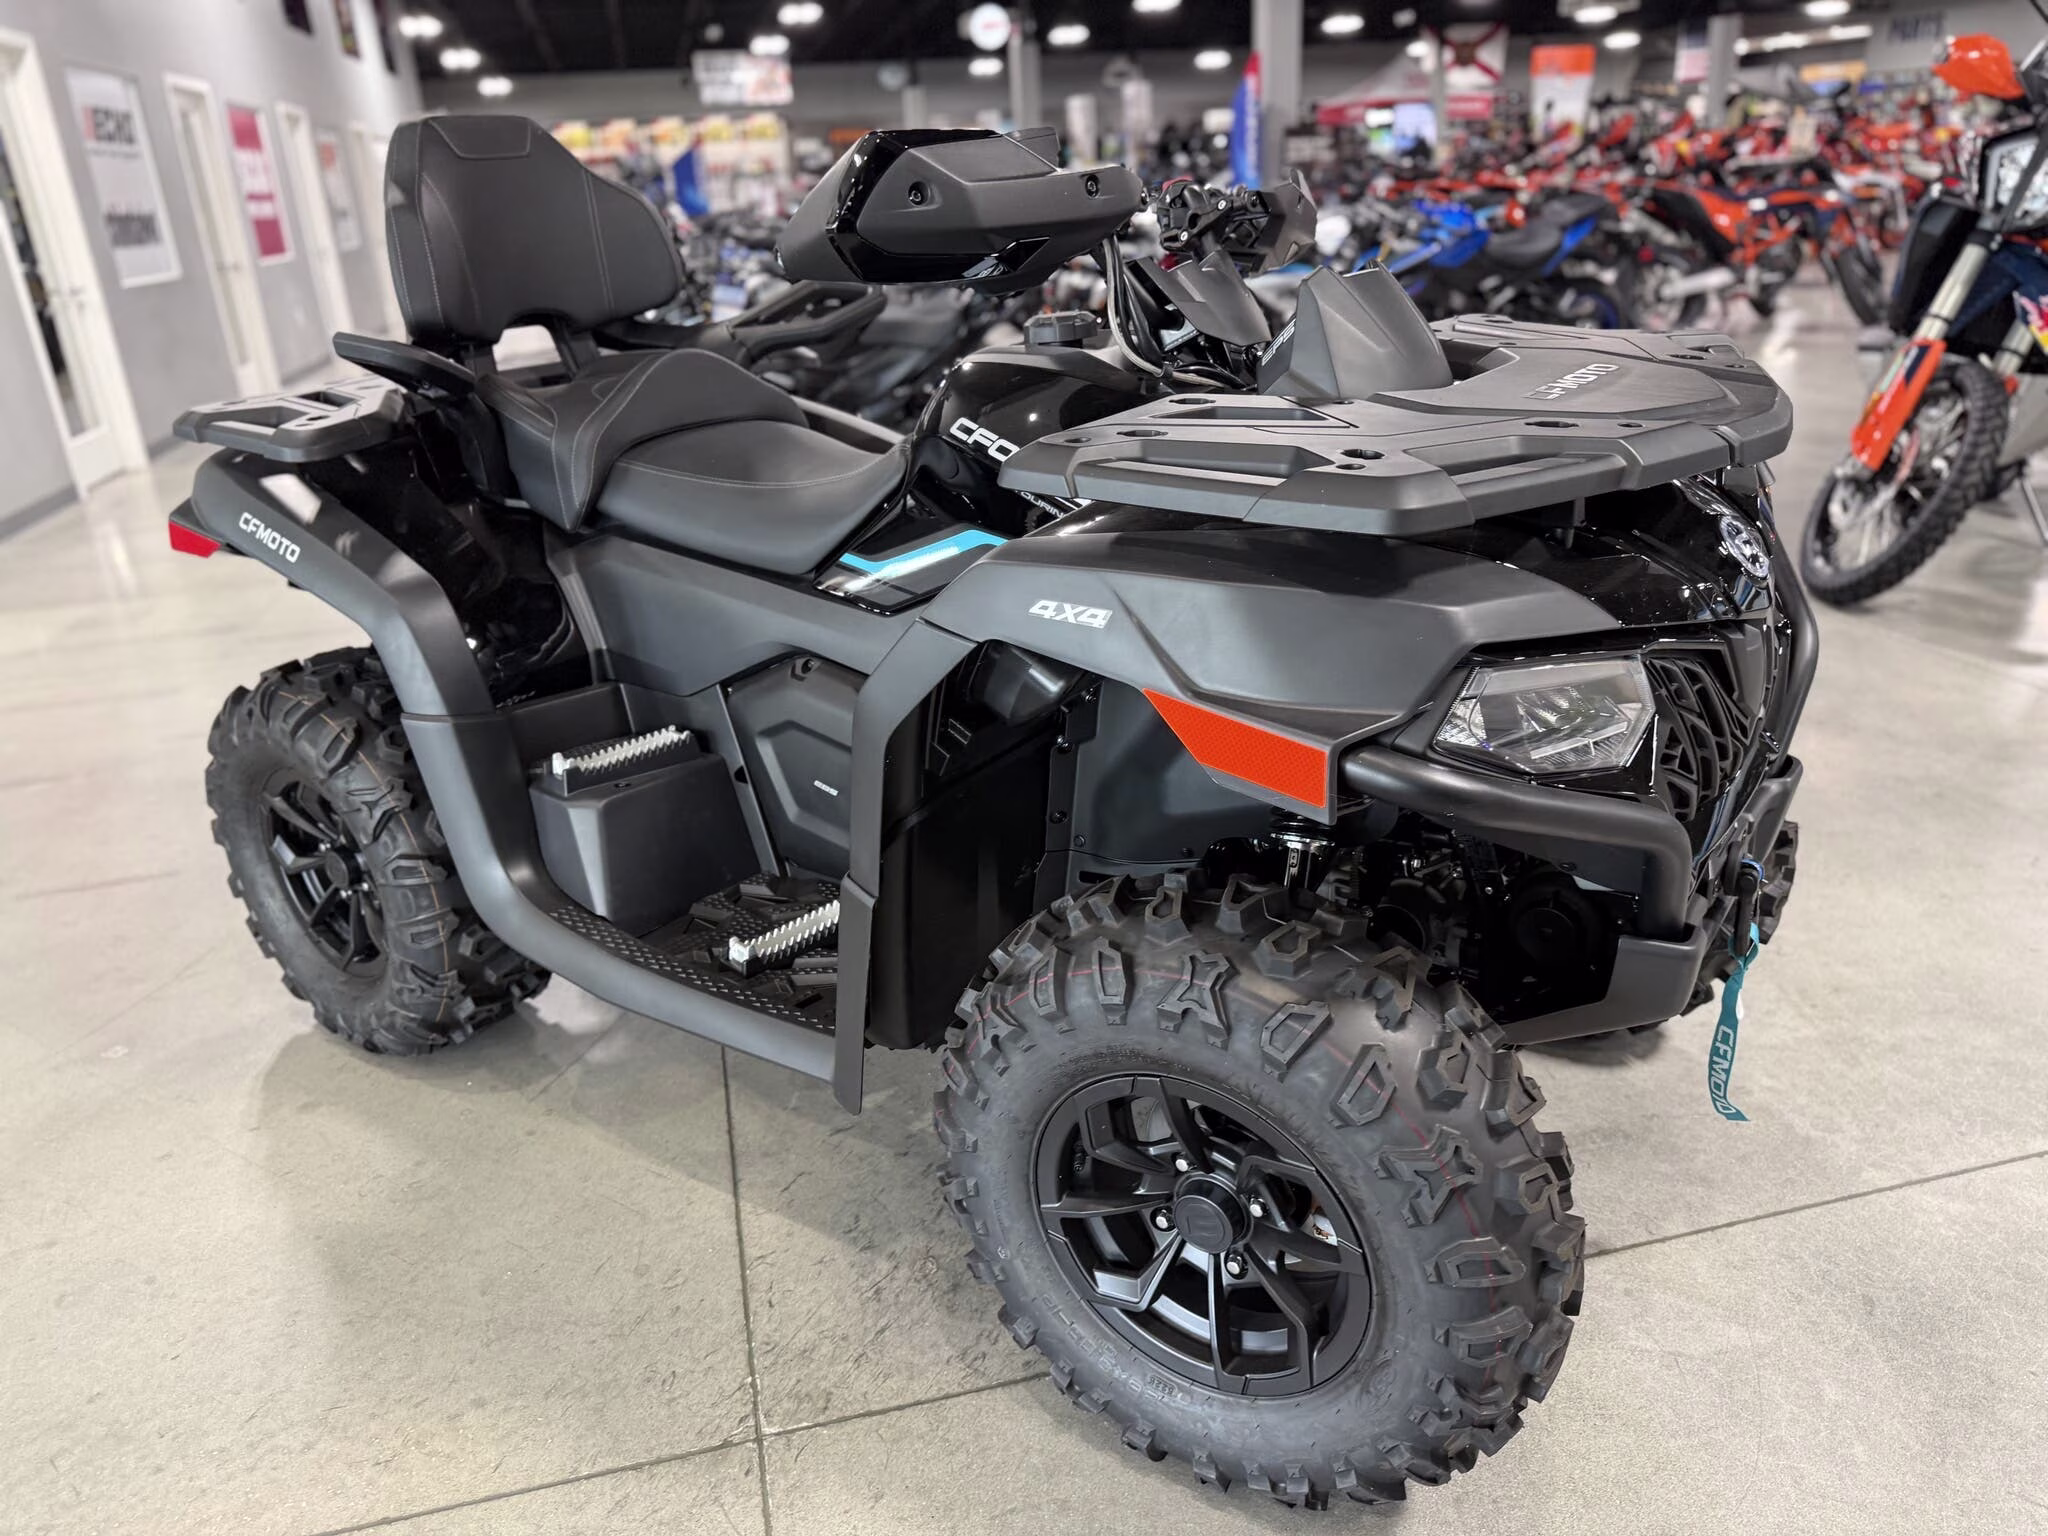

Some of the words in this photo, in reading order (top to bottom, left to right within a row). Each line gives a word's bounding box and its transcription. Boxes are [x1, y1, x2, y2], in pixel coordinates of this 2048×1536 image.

[1261, 318, 1296, 367] EPS
[1520, 363, 1620, 400] CFMOTO
[1015, 490, 1065, 519] OURIN
[238, 511, 301, 564] CFMOTO
[1710, 1024, 1737, 1114] CFMOTO
